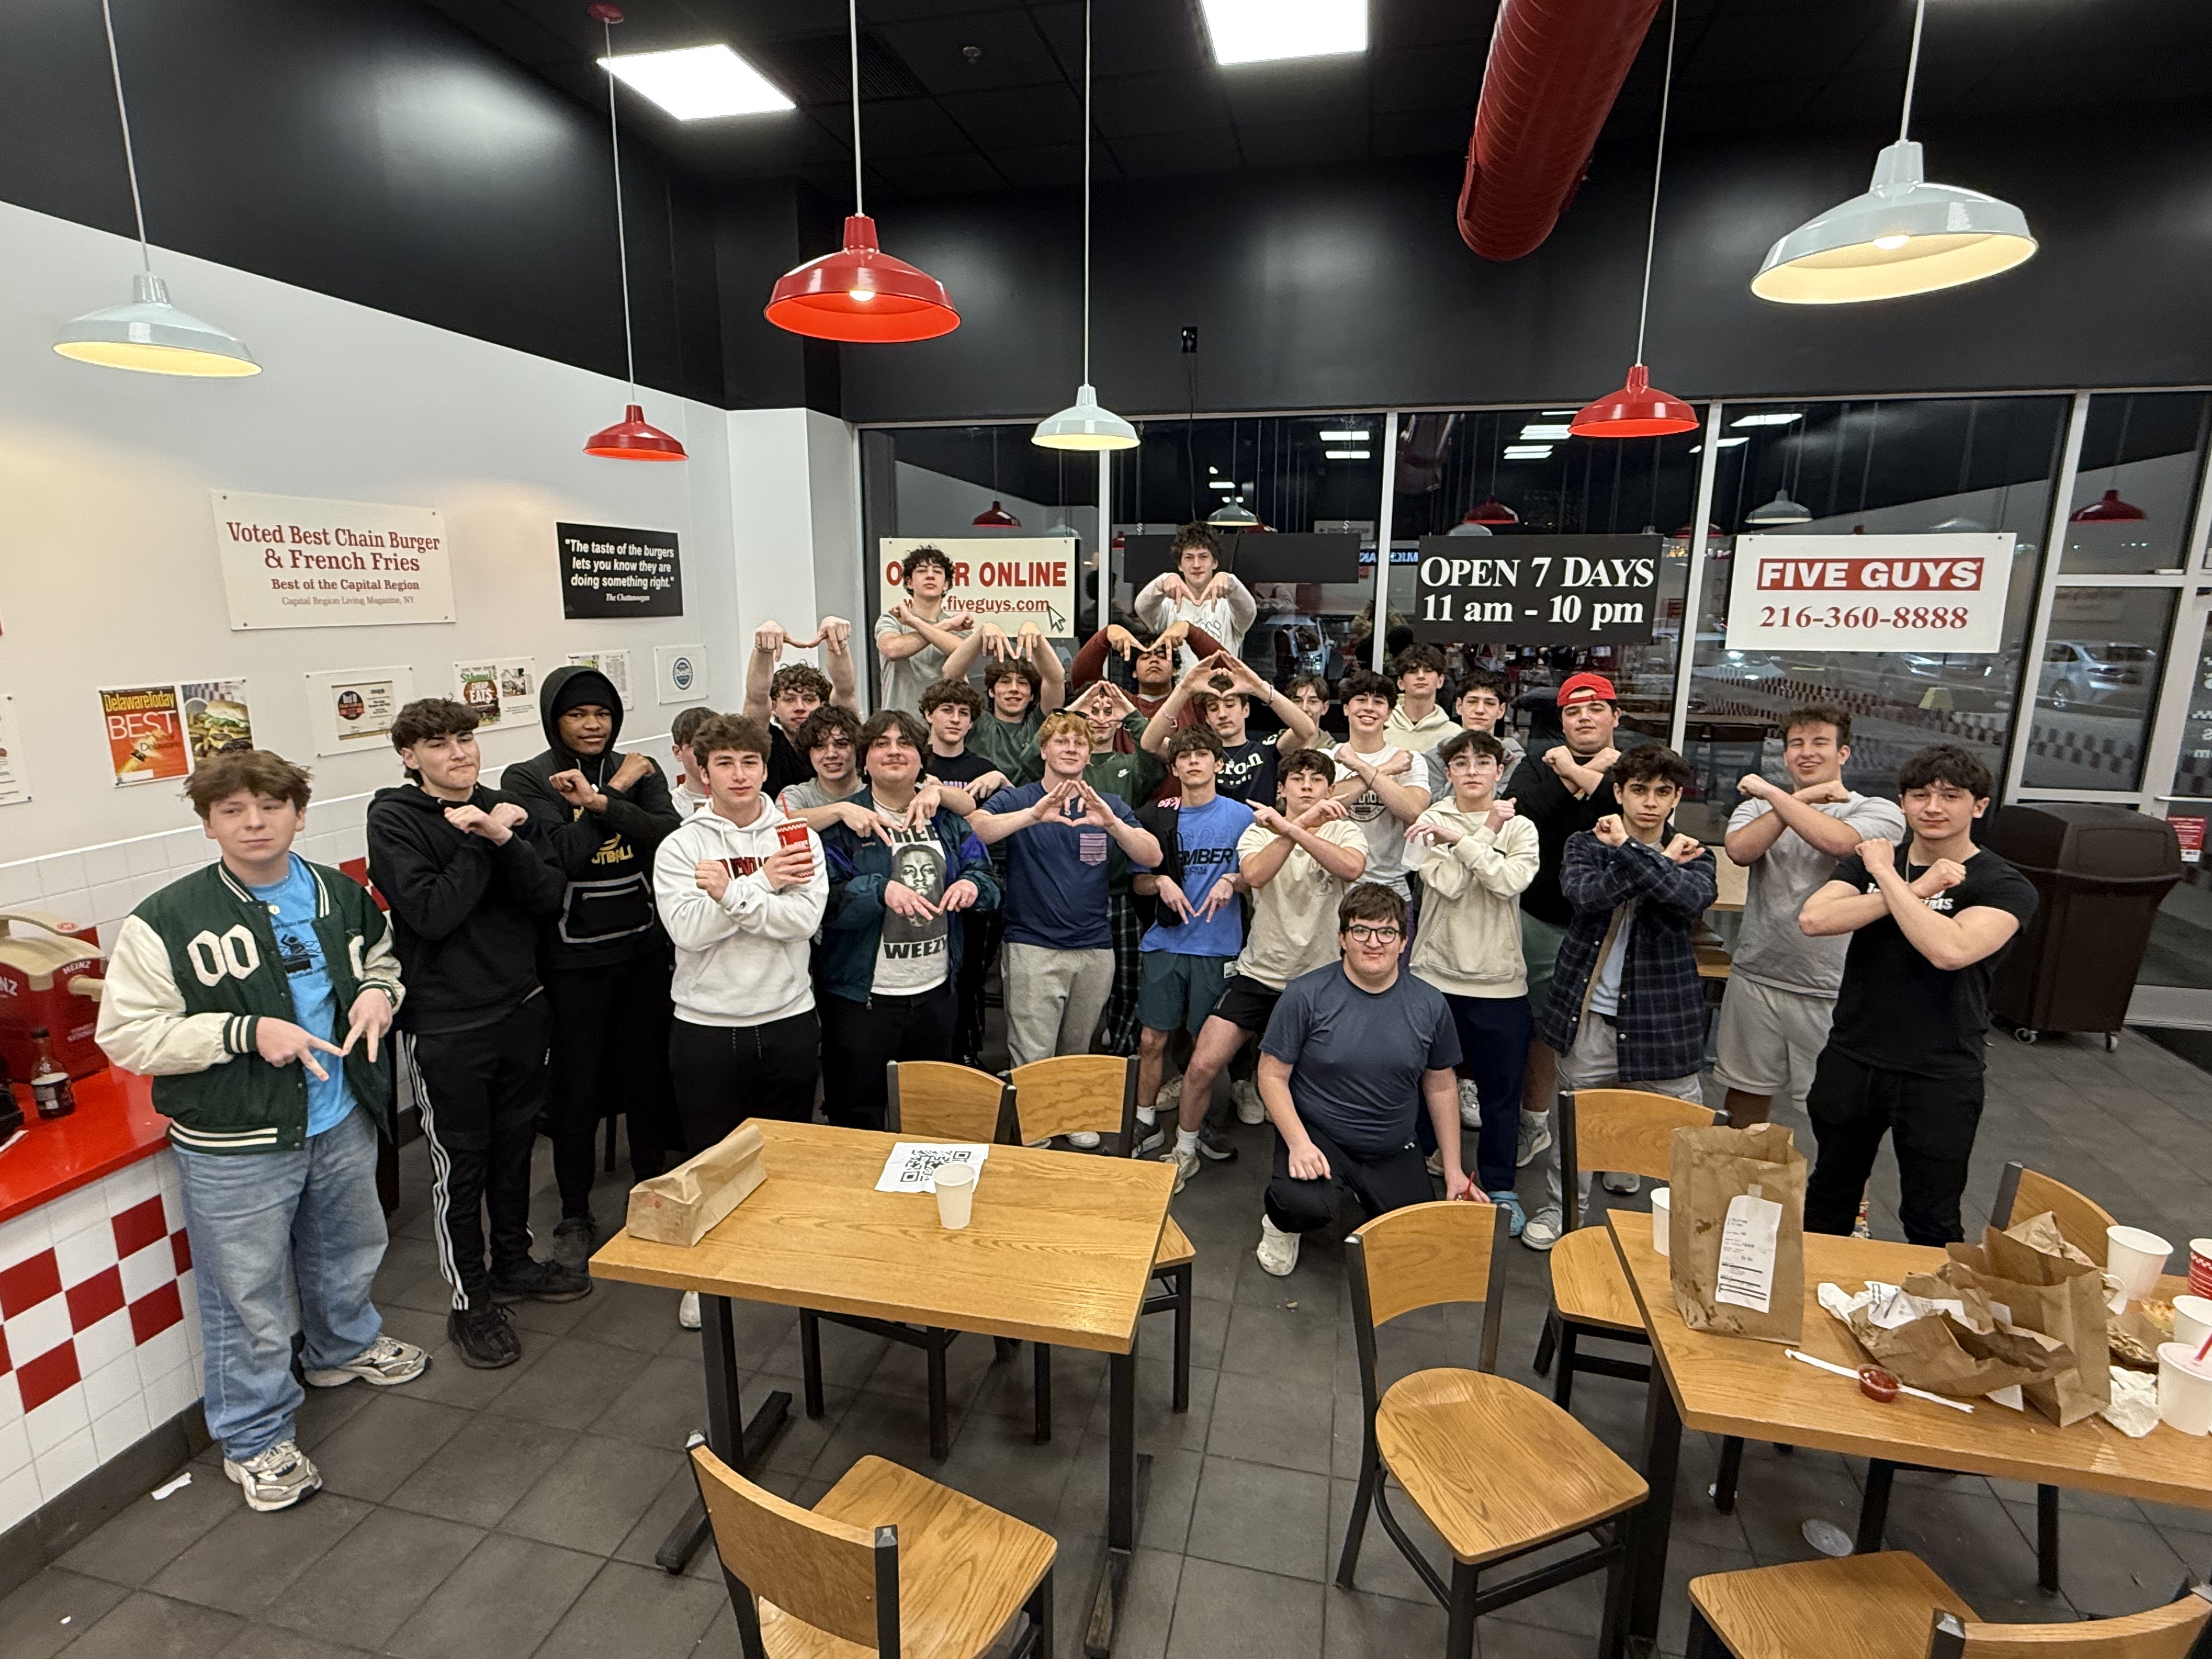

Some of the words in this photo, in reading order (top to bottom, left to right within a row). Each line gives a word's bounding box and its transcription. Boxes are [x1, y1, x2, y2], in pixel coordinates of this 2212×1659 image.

[227, 522, 285, 543] Voted
[289, 526, 329, 546] Best
[335, 528, 385, 548] Chain
[388, 532, 440, 553] Burger
[264, 549, 284, 568] &
[288, 549, 366, 570] French
[370, 552, 420, 572] Fries
[591, 541, 615, 555] taste
[617, 543, 627, 555] of
[629, 544, 642, 556] the
[644, 545, 675, 560] burgers
[572, 556, 591, 570] lets
[593, 560, 611, 573] you
[613, 558, 637, 572] know
[639, 560, 657, 574] they
[658, 563, 672, 573] are
[980, 562, 1066, 586] ONLINE
[1420, 557, 1521, 587] OPEN
[1531, 557, 1552, 587] 7
[1561, 557, 1654, 587] DAYS
[1761, 562, 1849, 587] FIVE
[1861, 562, 1978, 588] GUYS
[271, 578, 300, 590] Best
[303, 579, 314, 589] of
[318, 579, 337, 590] the
[340, 579, 381, 592] Capital
[384, 580, 420, 592] Region
[571, 574, 600, 590] doing
[601, 575, 648, 590] something
[281, 597, 311, 607] Capital
[313, 596, 340, 606] Region
[1423, 595, 1453, 621] 11
[1464, 602, 1513, 622] am
[1548, 595, 1581, 623] 10
[1590, 603, 1643, 630] pm
[1759, 606, 1968, 628] 216-360-8888
[470, 689, 495, 703] EATS
[108, 710, 176, 740] BEST
[62, 961, 91, 974] HEINZ
